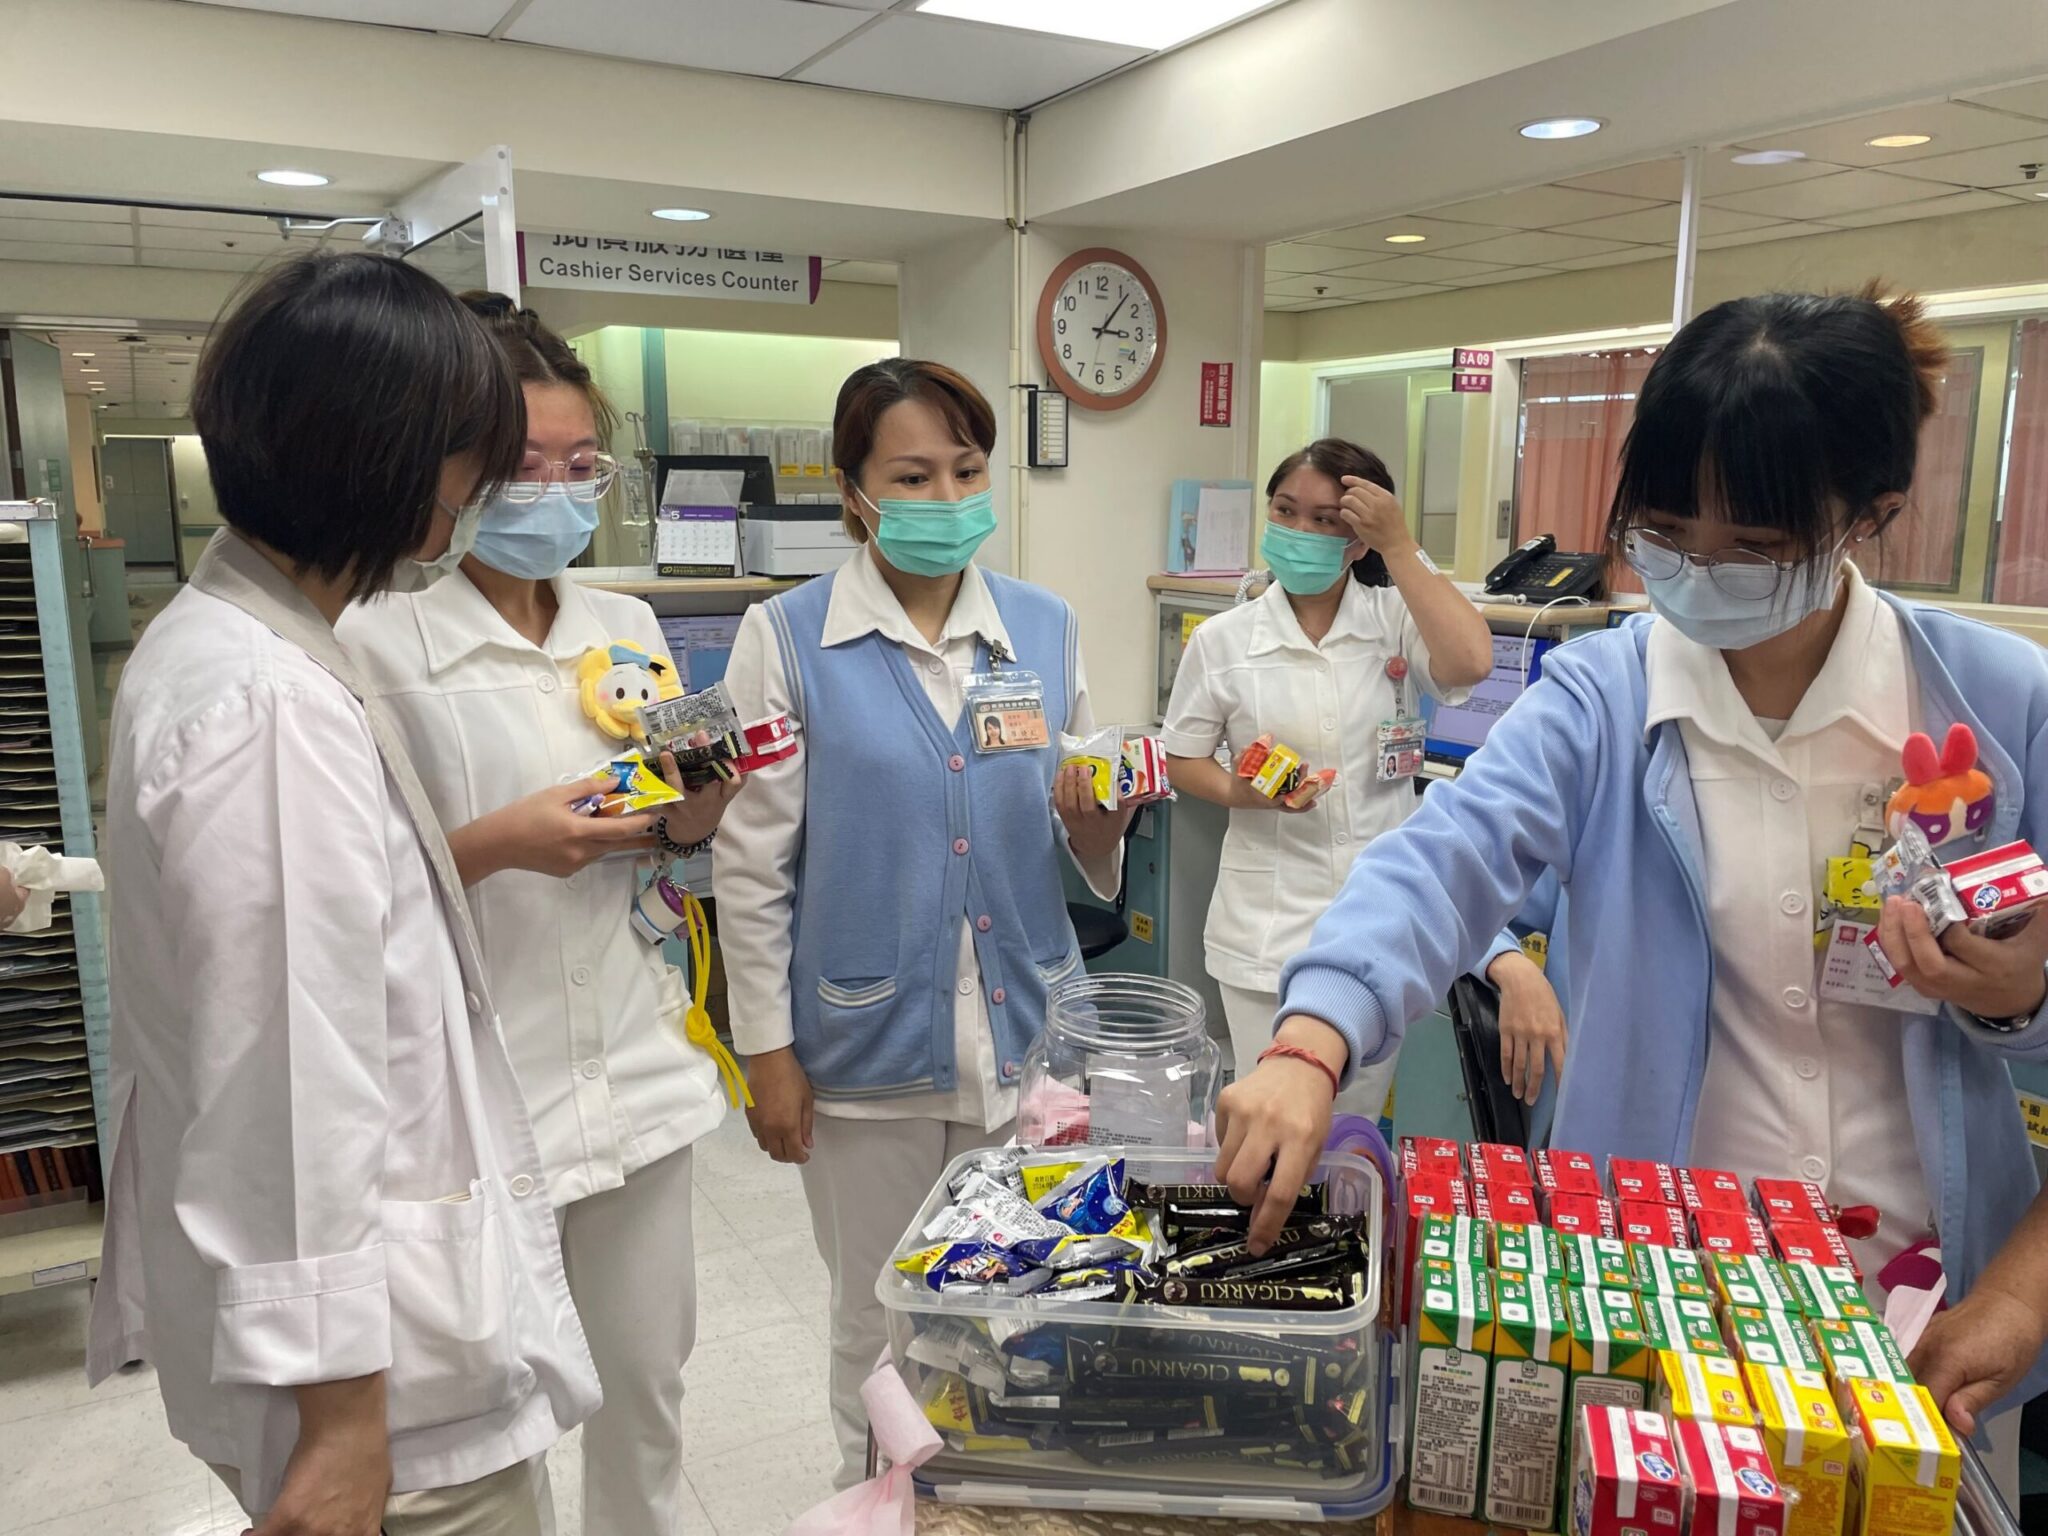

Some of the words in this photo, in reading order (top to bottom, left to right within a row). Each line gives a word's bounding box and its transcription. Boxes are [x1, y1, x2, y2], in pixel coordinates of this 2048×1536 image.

[539, 257, 622, 281] Cashier
[628, 264, 717, 287] Services
[722, 271, 800, 293] Counter
[1078, 280, 1089, 295] 11
[1096, 276, 1109, 291] 12
[1063, 296, 1076, 311] 10
[1130, 304, 1139, 319] 2
[1057, 319, 1067, 334] 9
[1134, 327, 1143, 342] 3
[1062, 343, 1072, 359] 8
[1127, 351, 1137, 364] 4
[1459, 352, 1490, 366] 6A09
[1077, 362, 1085, 377] 7
[1095, 370, 1104, 384] 6
[1114, 366, 1122, 380] 5
[1177, 1185, 1229, 1198] ARKU
[1200, 1283, 1295, 1301] CIGARKU
[1131, 1357, 1230, 1381] CIGARKU
[1625, 1389, 1640, 1401] 10
